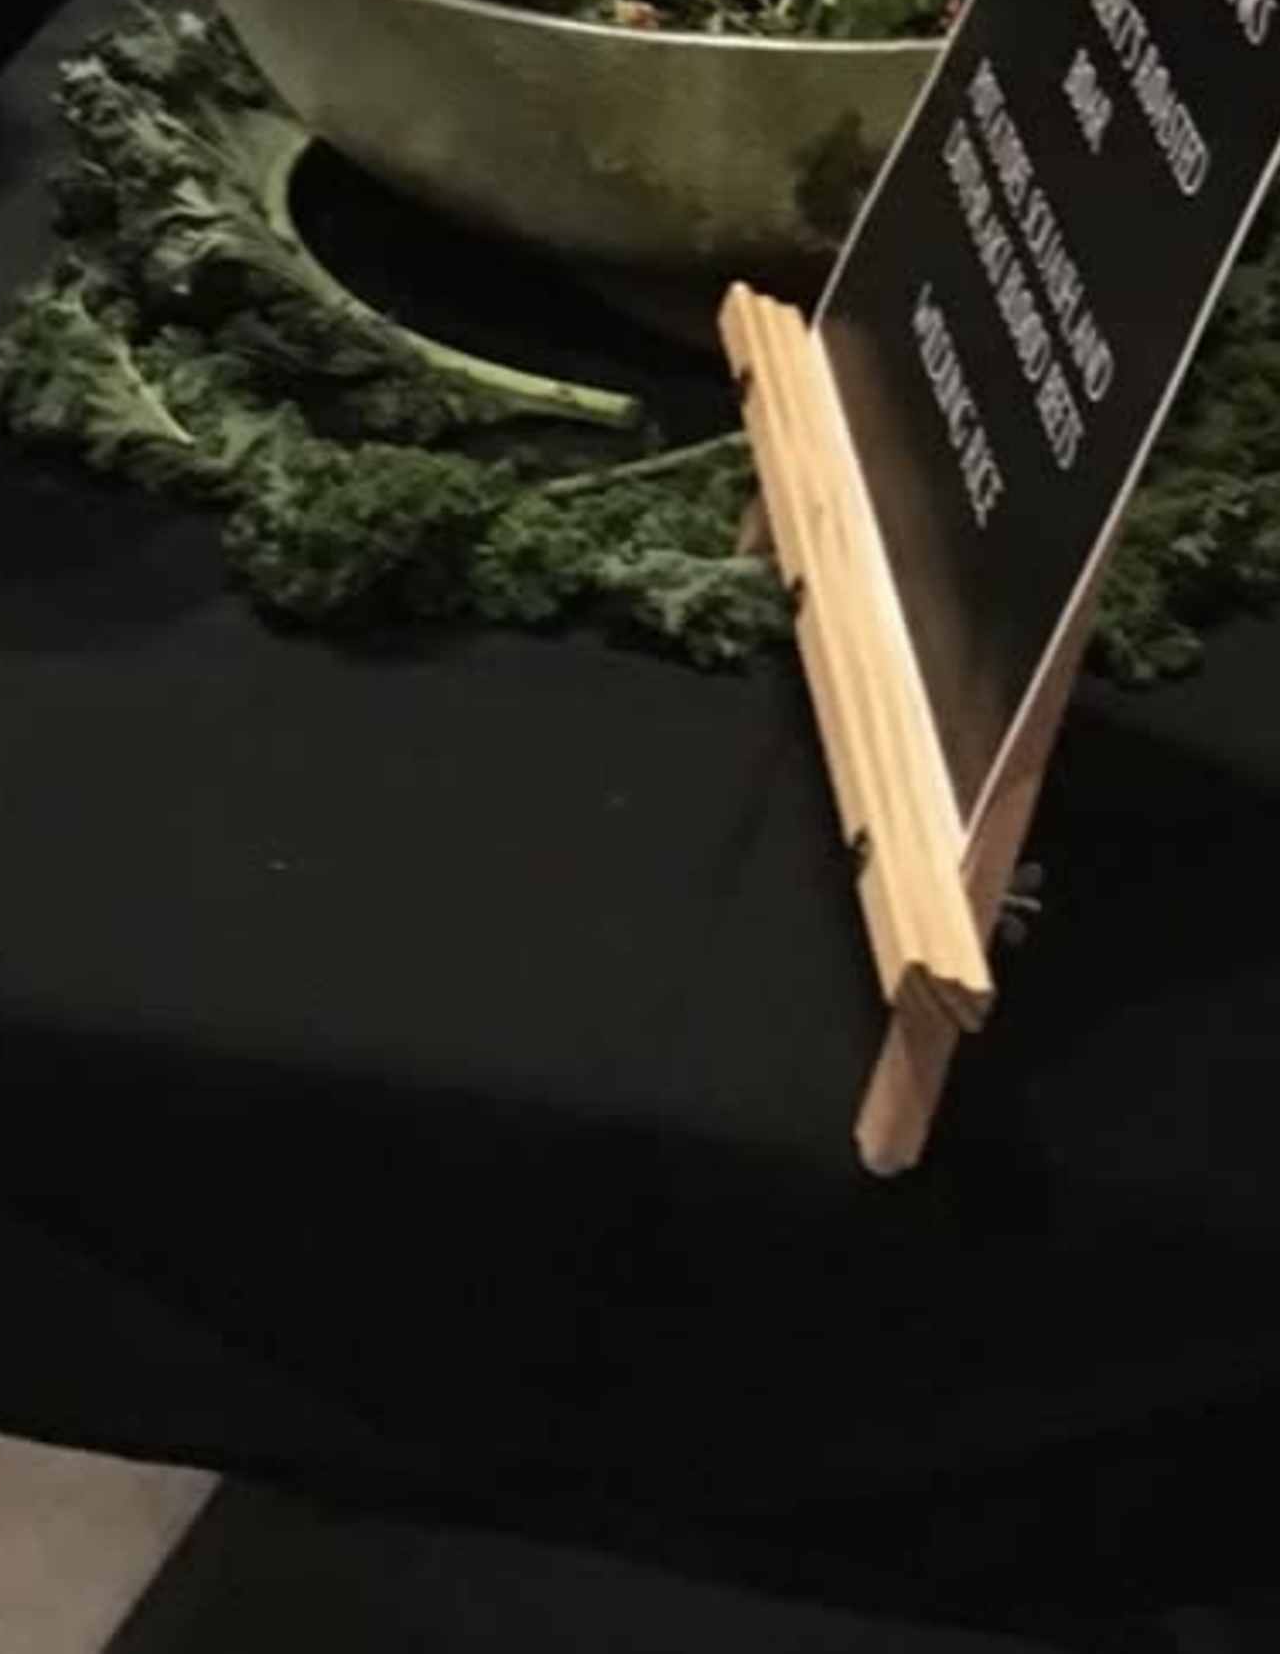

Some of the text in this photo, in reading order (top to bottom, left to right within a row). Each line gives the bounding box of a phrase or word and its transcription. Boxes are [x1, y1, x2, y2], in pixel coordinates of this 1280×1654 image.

[1131, 44, 1209, 196] ROASTED
[1068, 312, 1113, 402] AND
[1035, 362, 1084, 470] BEETS
[959, 426, 1004, 529] RICE
